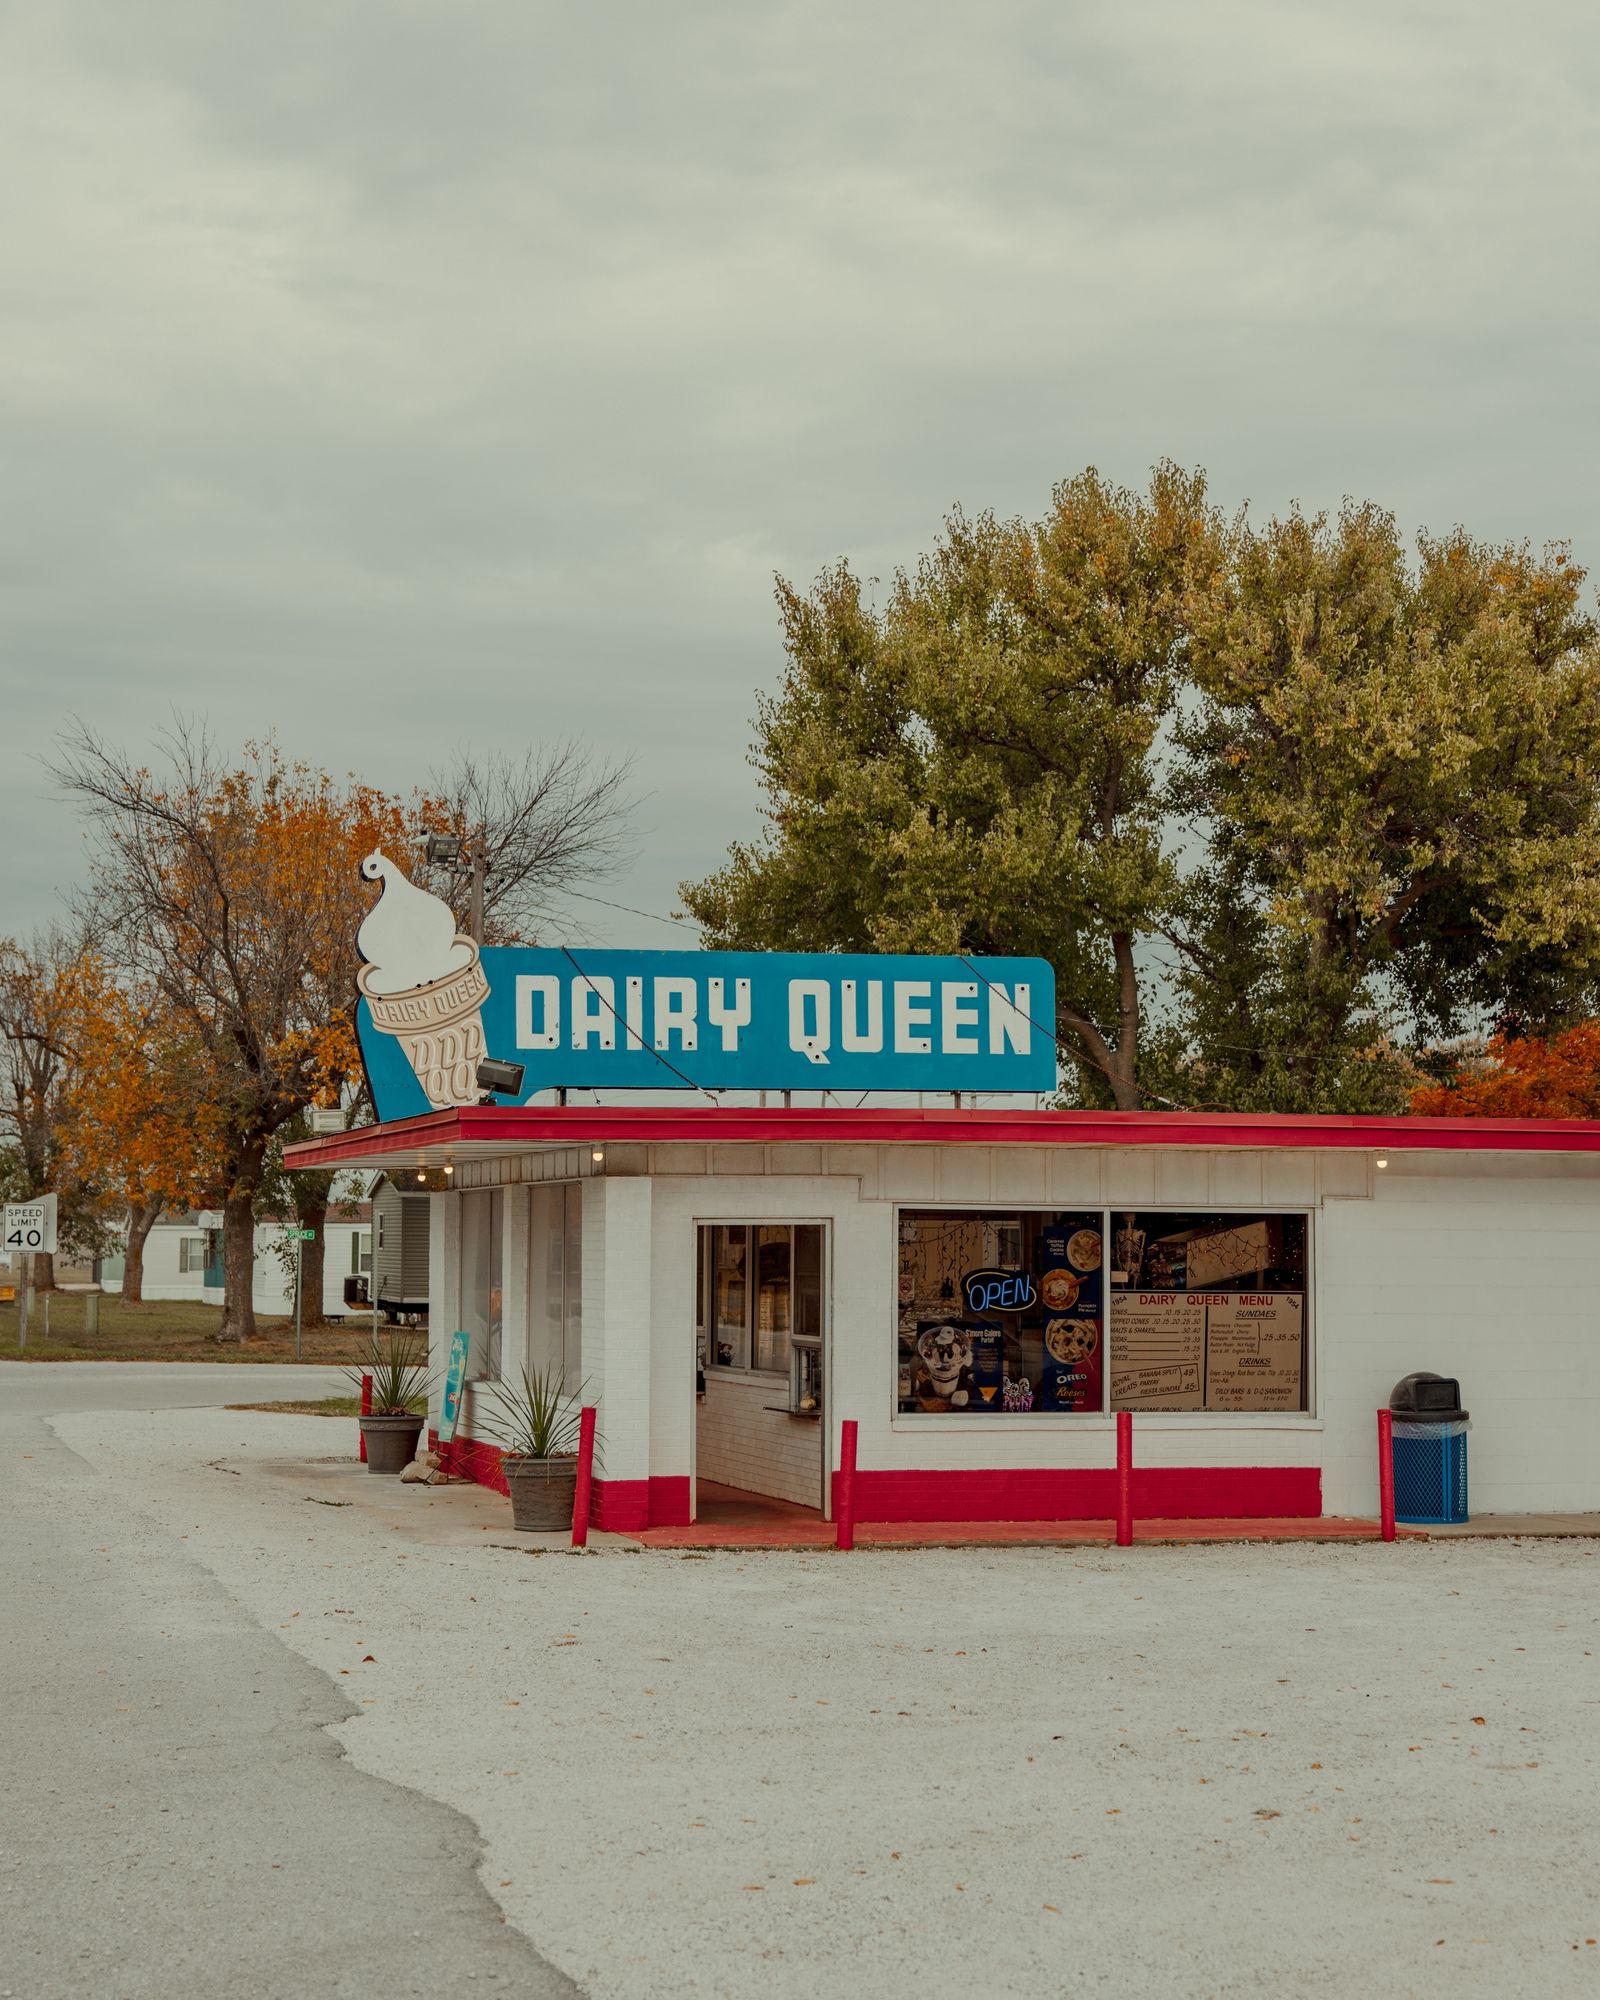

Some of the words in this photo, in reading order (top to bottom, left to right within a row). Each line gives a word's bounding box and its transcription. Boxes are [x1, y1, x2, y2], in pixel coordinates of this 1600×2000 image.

[373, 998, 431, 1022] DAIRY
[434, 969, 485, 1015] QUEEN
[516, 975, 751, 1052] DAIRY
[788, 979, 1031, 1065] QUEEN
[8, 1209, 42, 1217] SPEED
[7, 1230, 41, 1247] 40
[970, 1274, 1030, 1311] OPEN
[1112, 1295, 1127, 1306] 1954
[1140, 1295, 1177, 1305] DAIRY
[1187, 1295, 1229, 1306] QUEEN
[1239, 1295, 1273, 1306] MENU
[1286, 1296, 1300, 1309] 1954
[1235, 1310, 1277, 1318] SUNDAES
[1238, 1357, 1271, 1365] DRINKS
[1056, 1373, 1087, 1384] OREO
[1138, 1370, 1162, 1378] BANANA
[1162, 1368, 1178, 1376] SPLIT
[1112, 1375, 1131, 1389] ROYAL
[1114, 1381, 1138, 1397] TREATS
